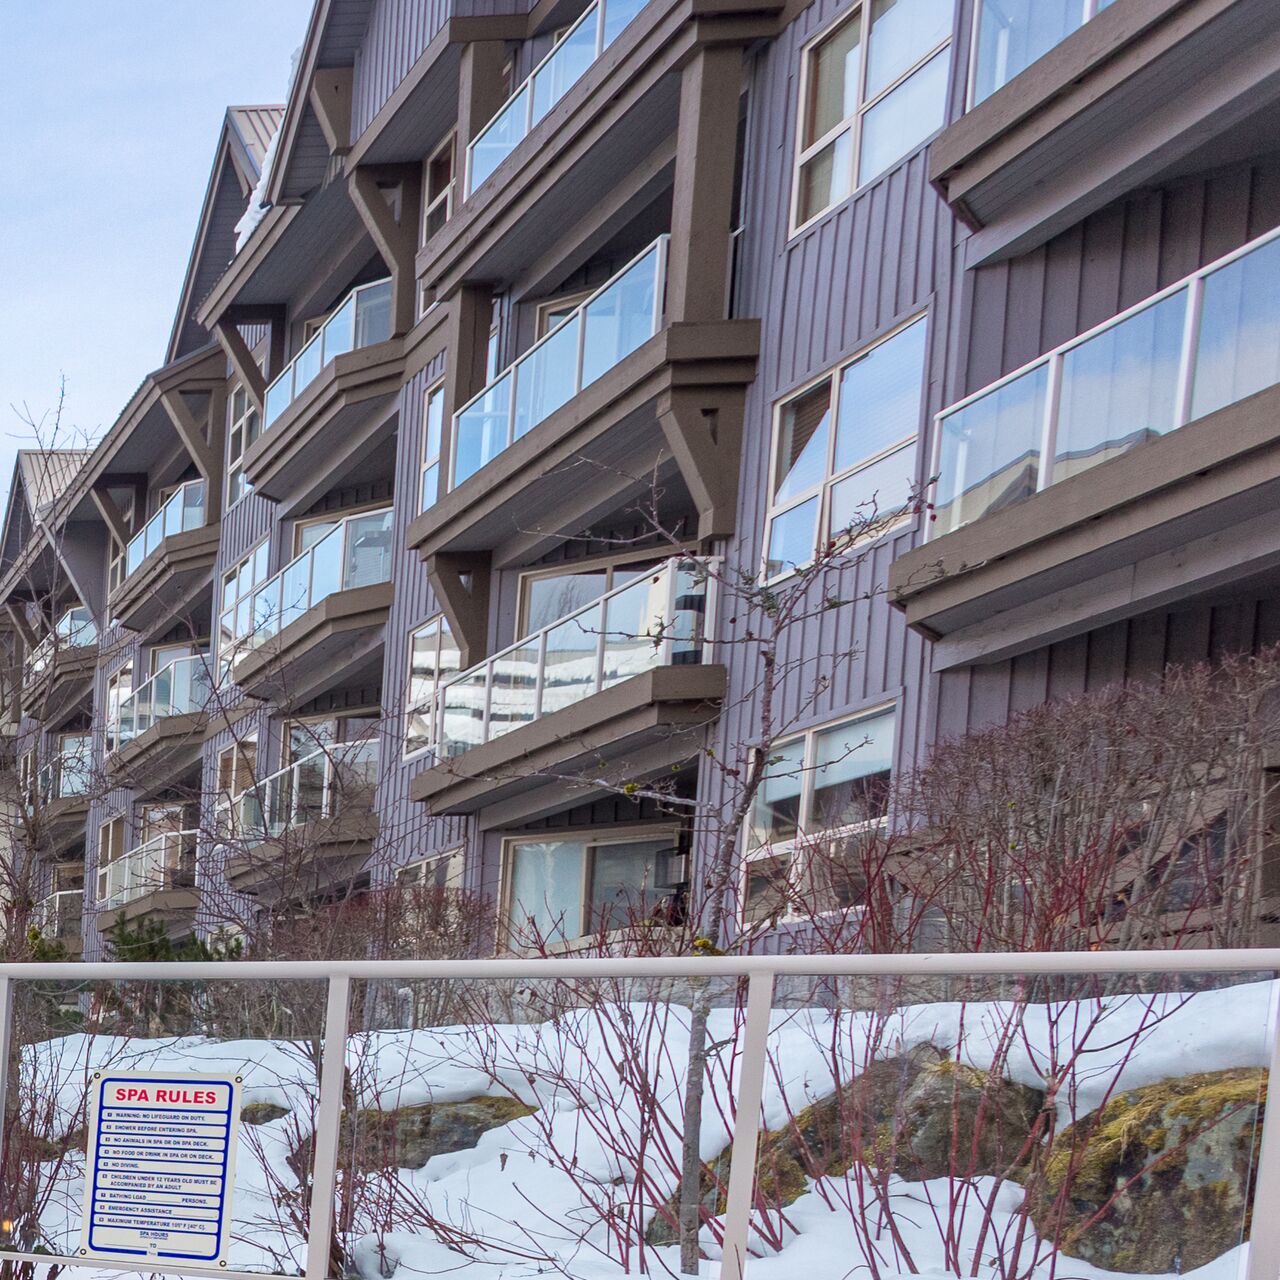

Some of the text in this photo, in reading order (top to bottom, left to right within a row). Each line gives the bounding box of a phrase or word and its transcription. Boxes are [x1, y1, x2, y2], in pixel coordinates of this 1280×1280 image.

[116, 1088, 216, 1104] SPA RULES
[133, 1219, 170, 1227] TEMPERATURE
